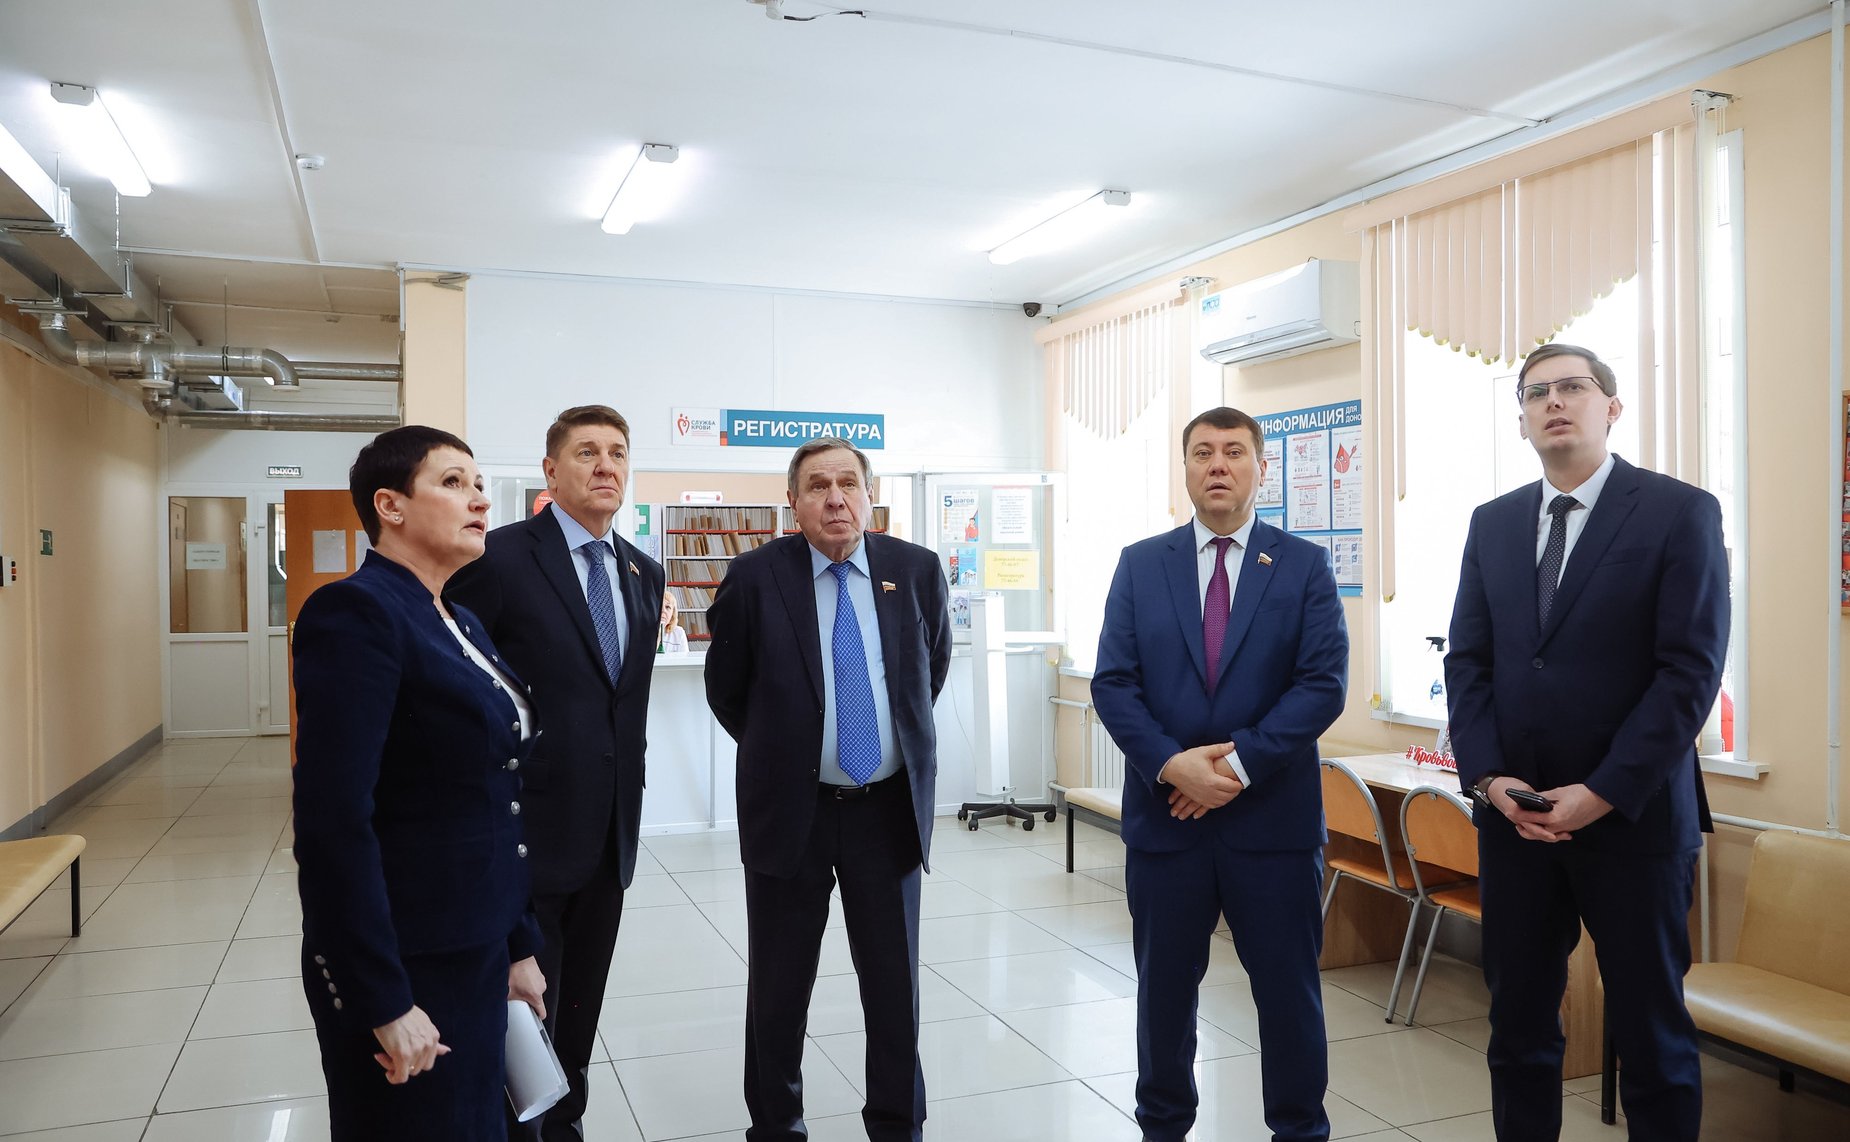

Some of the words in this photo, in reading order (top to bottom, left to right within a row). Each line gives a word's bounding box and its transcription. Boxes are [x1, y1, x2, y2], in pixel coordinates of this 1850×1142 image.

[1257, 407, 1344, 435] ИНФОРМАЦИЯ
[733, 419, 882, 440] РЕГИСТРАТУРА
[269, 467, 300, 475] ВЫХОД
[944, 495, 953, 507] 5
